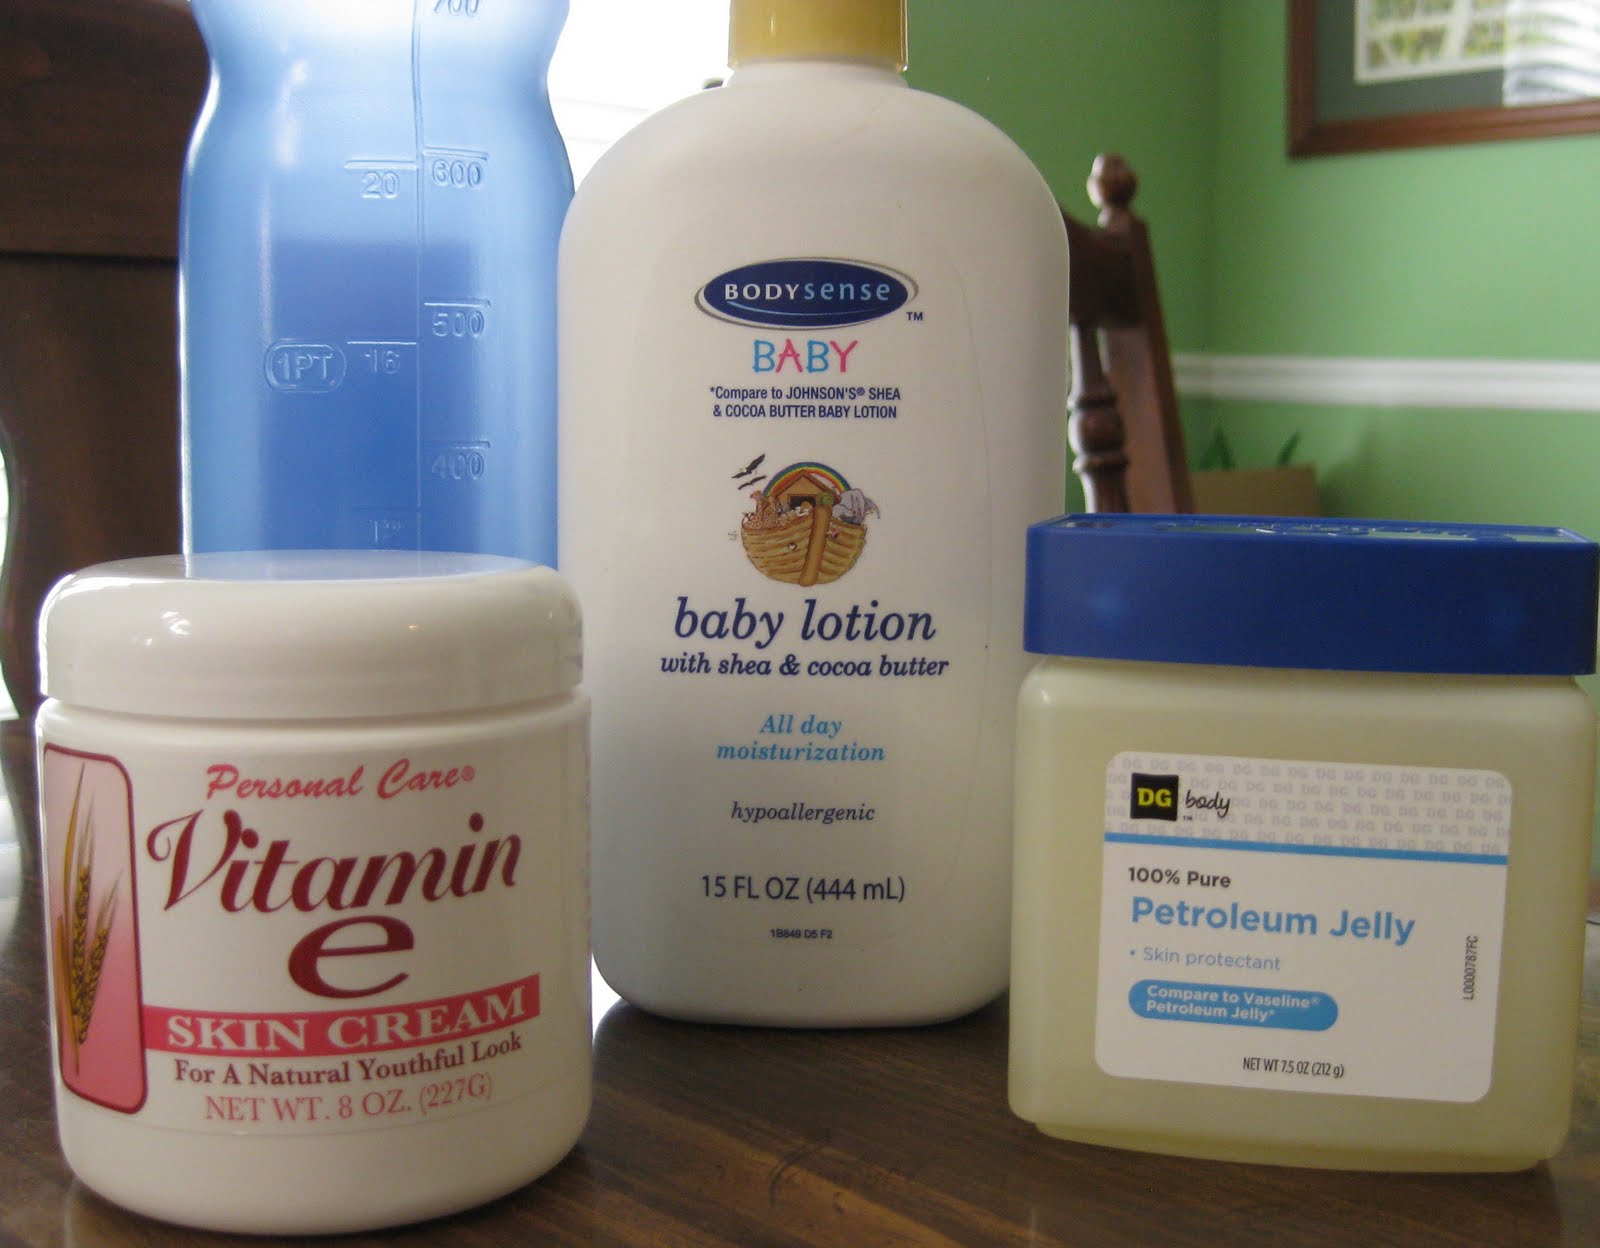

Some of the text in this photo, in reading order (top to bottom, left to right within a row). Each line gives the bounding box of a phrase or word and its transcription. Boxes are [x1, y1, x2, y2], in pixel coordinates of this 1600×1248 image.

[361, 171, 399, 199] 20
[432, 160, 483, 189] 600
[724, 282, 891, 302] BODYsense
[433, 311, 484, 338] 500
[365, 348, 400, 375] 16
[752, 338, 858, 373] BABY
[770, 387, 783, 401] to
[868, 387, 901, 402] SHEA
[712, 405, 897, 419] & COCOA BUTTER BABY LOTION
[432, 452, 485, 480] 400
[673, 596, 937, 650] baby lotion
[660, 652, 950, 677] with shea & cocoa butter
[759, 714, 842, 740] All day
[715, 740, 886, 762] moisturization
[205, 763, 366, 801] Personal
[730, 801, 876, 825] hypoallergenic
[1137, 787, 1231, 819] DG body
[147, 808, 522, 914] Vitamin
[701, 875, 906, 904] 15 FL OZ (444 mL)
[1128, 866, 1232, 888] 100% Pure
[1131, 895, 1416, 947] Petroleum Jelly
[288, 915, 415, 999] e
[1143, 946, 1281, 971] Skin protectant
[1146, 985, 1219, 1003] Compare
[1222, 990, 1239, 1005] to
[167, 984, 528, 1052] SKIN CREAM
[1146, 1000, 1228, 1018] Petroleum
[174, 1030, 523, 1086] For A Natural Youthful Look
[1242, 1057, 1261, 1072] NET
[1263, 1059, 1280, 1073] WT
[1295, 1061, 1310, 1076] OZ
[1312, 1062, 1331, 1077] (212
[1333, 1064, 1345, 1079] g)
[204, 1072, 494, 1122] NET WT. 8 OZ. (227G)
